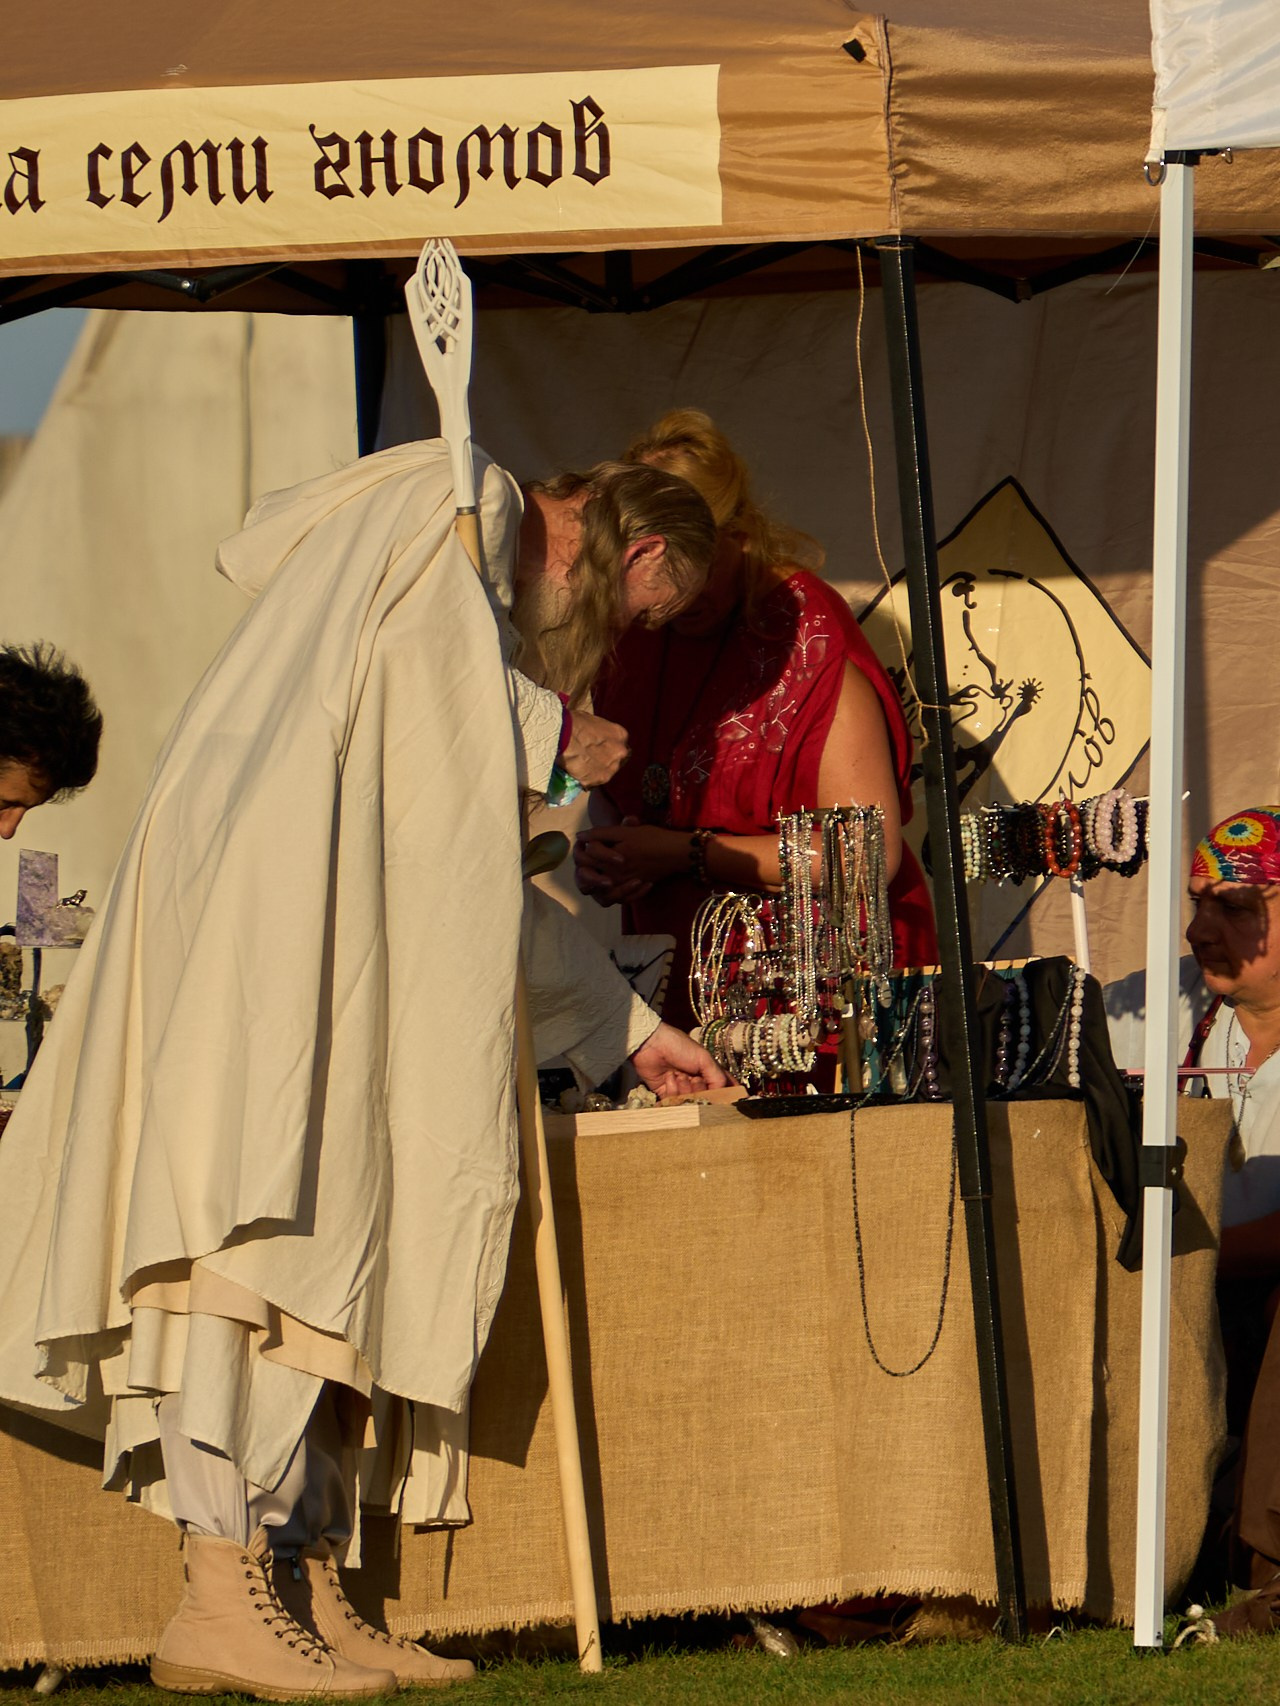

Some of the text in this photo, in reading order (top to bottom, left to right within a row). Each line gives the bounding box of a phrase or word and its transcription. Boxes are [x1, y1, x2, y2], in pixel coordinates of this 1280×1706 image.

[0, 95, 611, 223] а семи гномов
